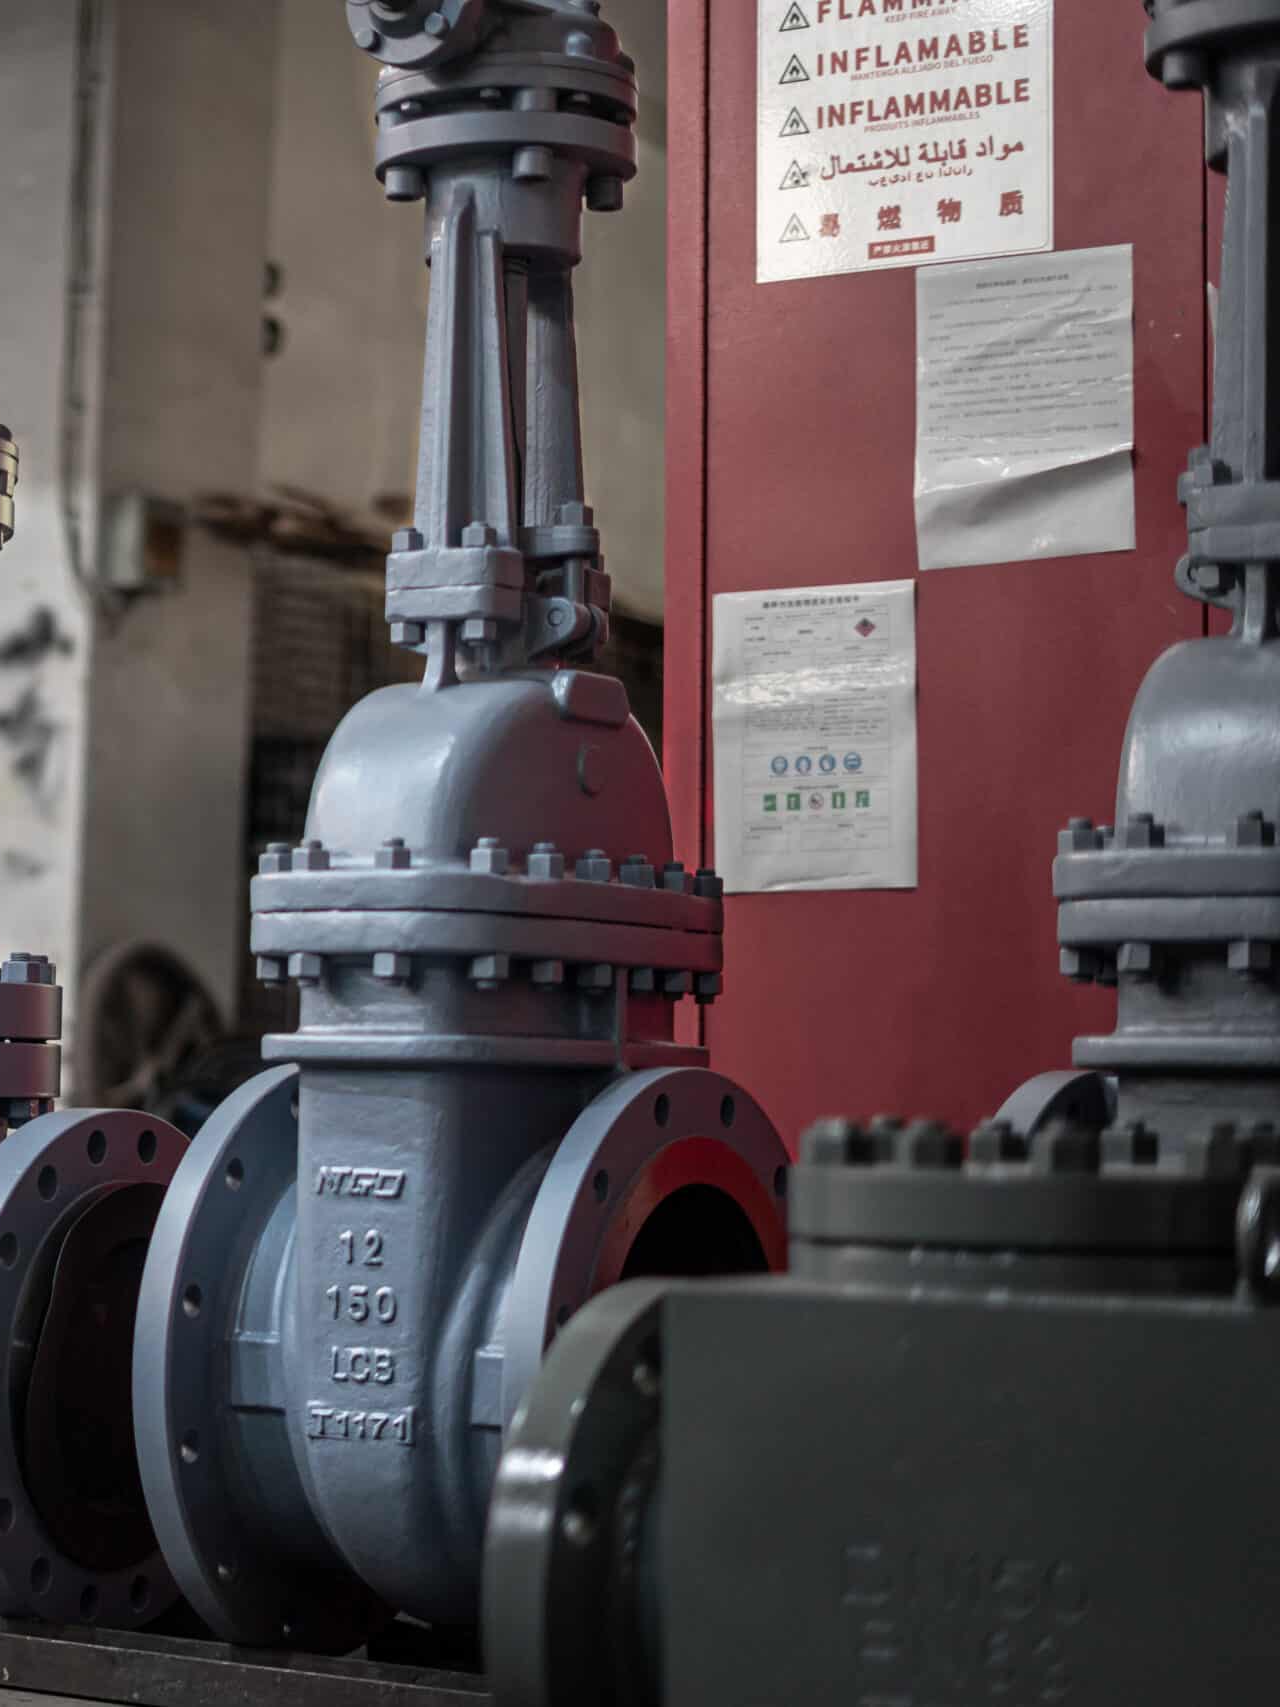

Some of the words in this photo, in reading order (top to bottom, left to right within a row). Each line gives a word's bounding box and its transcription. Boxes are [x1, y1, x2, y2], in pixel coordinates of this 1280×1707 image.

[817, 24, 1029, 76] INFLAMABLE
[817, 78, 1030, 129] INFLAMMABLE
[338, 1229, 385, 1267] 12
[326, 1285, 399, 1324] 150
[330, 1346, 396, 1385] LCB
